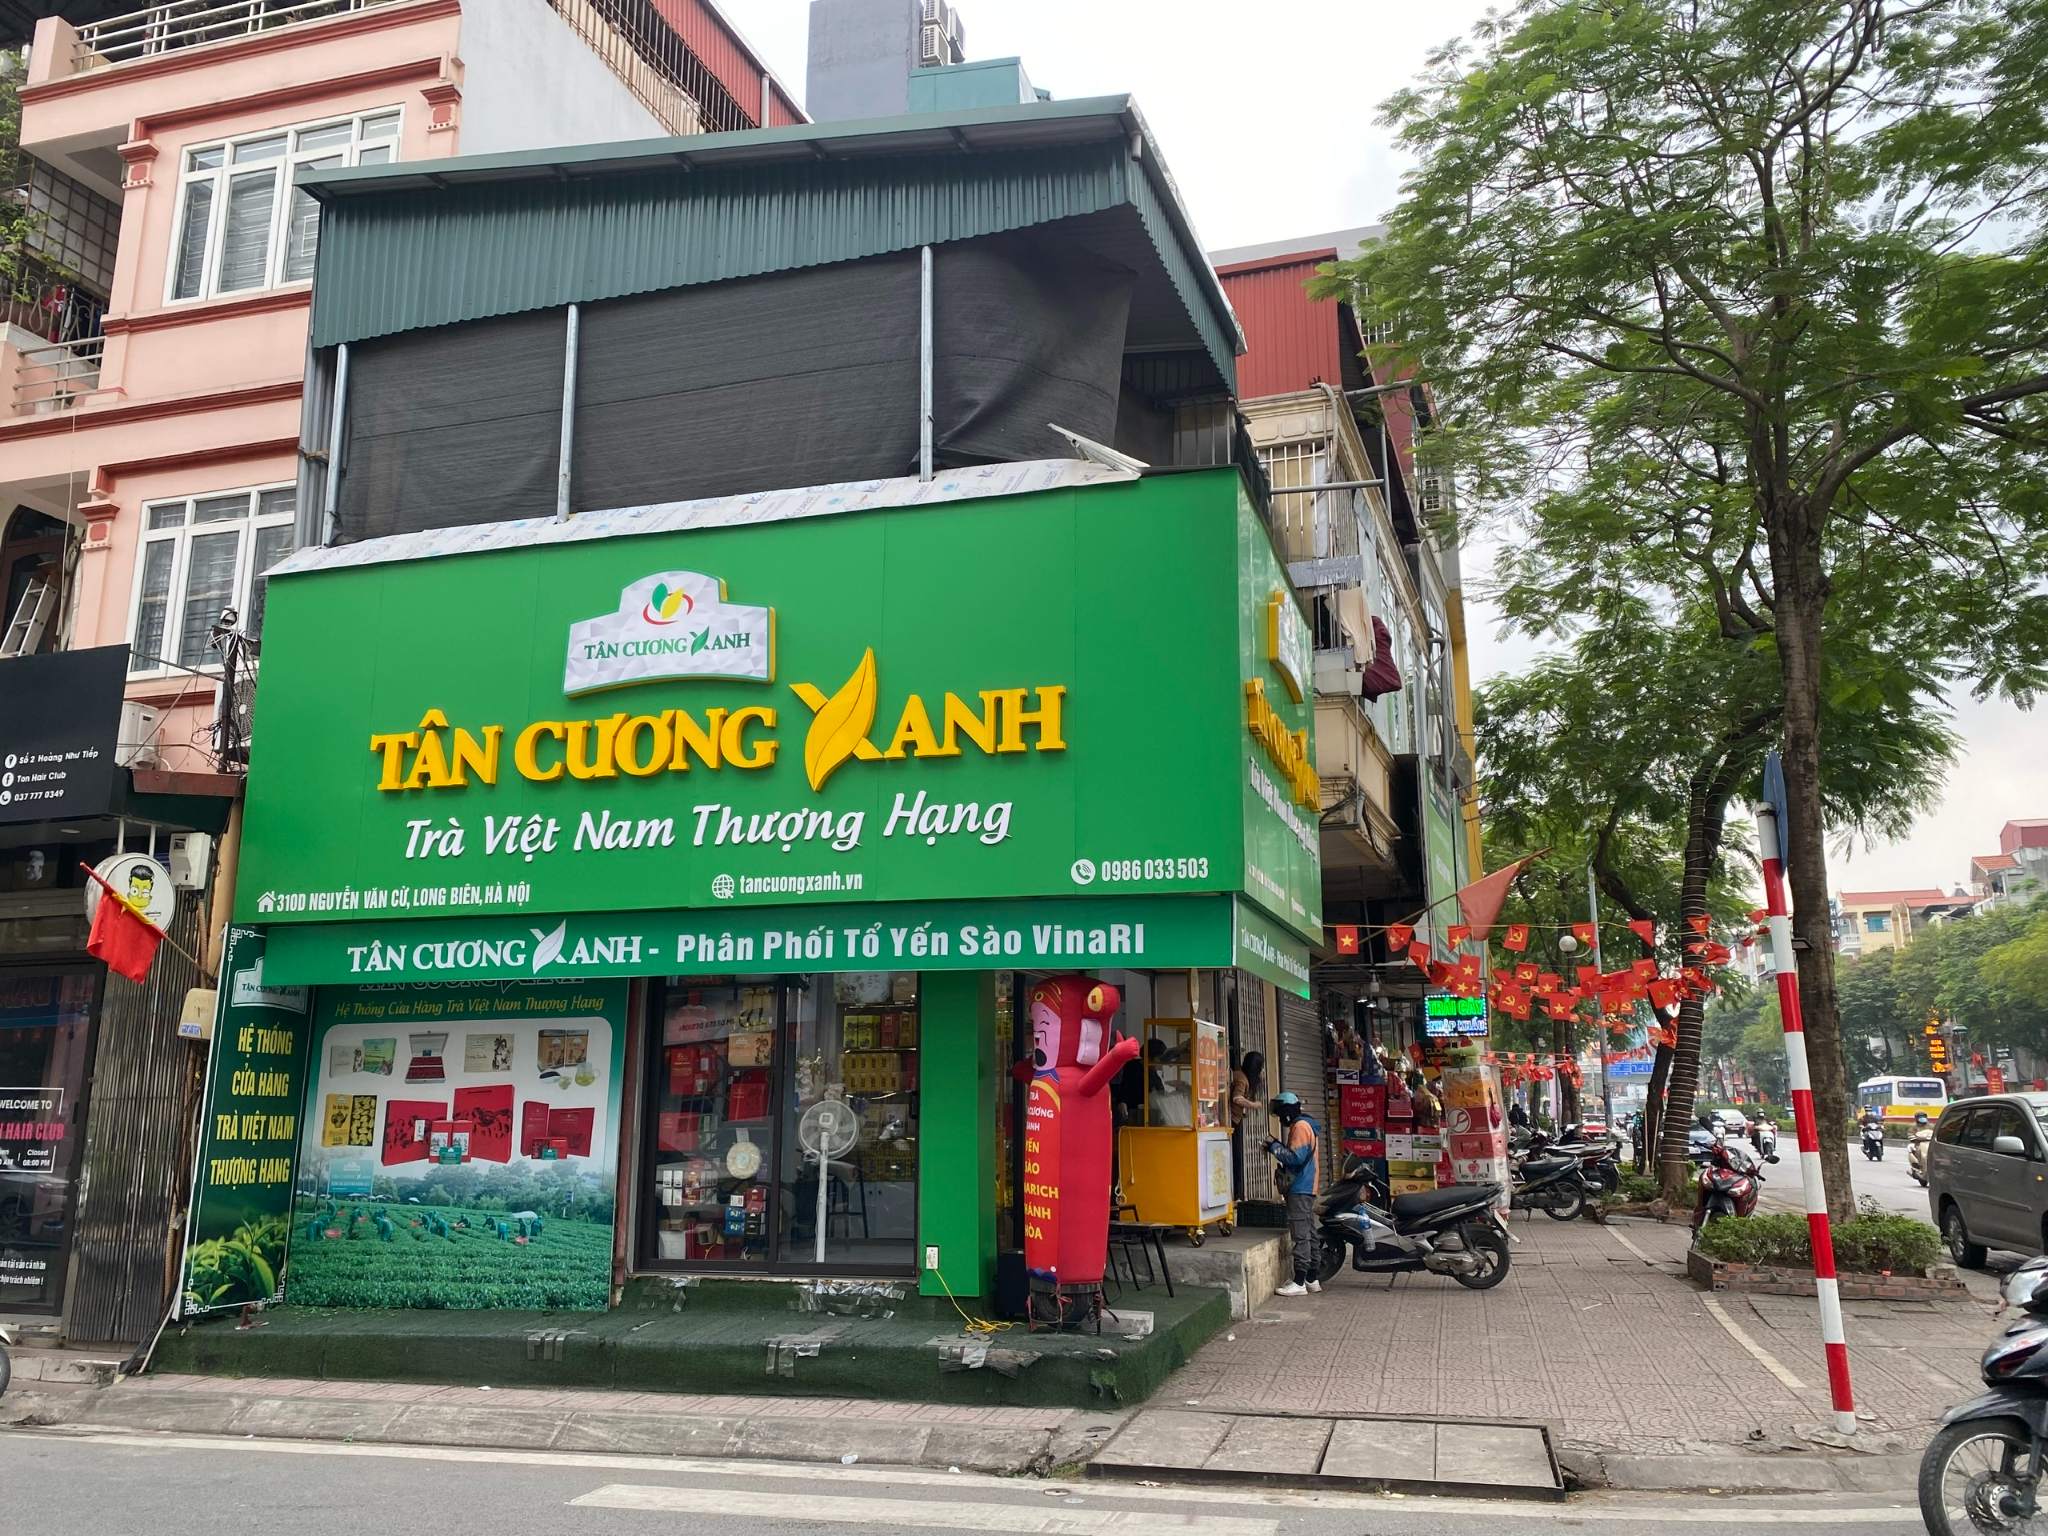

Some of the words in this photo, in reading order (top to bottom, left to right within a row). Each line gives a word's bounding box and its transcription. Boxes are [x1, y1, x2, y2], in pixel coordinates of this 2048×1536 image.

[584, 640, 619, 660] TÂN
[623, 637, 687, 658] CƯƠNG
[30, 755, 35, 763] 2
[370, 707, 503, 792] TÂN
[514, 705, 779, 782] CƯƠNG
[31, 773, 47, 782] Hair
[48, 771, 66, 780] Club
[14, 792, 28, 801] 037
[29, 791, 43, 800] 777
[44, 789, 64, 799] 0349
[404, 817, 466, 859] Trà
[484, 813, 561, 862] Việt
[574, 809, 675, 852] Nam
[692, 803, 865, 853] Thượng
[883, 790, 1014, 846] Hạng
[1102, 860, 1141, 882] 0986
[1144, 858, 1175, 880] 033
[1177, 857, 1209, 879] 503
[739, 871, 863, 895] tancuongxanh.vn
[277, 893, 306, 912] 310D
[309, 885, 360, 911] NGUYỄN
[364, 887, 387, 909] VĂN
[413, 887, 447, 907] LONG
[485, 881, 503, 904] HÀ
[507, 881, 530, 906] NỘI
[347, 939, 407, 973] TÂN
[412, 939, 526, 971] CƯƠNG
[676, 932, 754, 963] Phân
[763, 924, 833, 961] Phối
[843, 921, 880, 959] Tổ
[889, 921, 949, 957] Yến
[959, 924, 1022, 956] Sào
[1032, 923, 1145, 956] VinaRI
[493, 998, 521, 1011] Nam
[571, 994, 605, 1011] Hạng
[238, 1022, 255, 1058] HỆ
[256, 1021, 293, 1055] THỐNG
[231, 1062, 255, 1096] CỬA
[257, 1067, 290, 1097] HÀNG
[41, 1100, 52, 1110] TO
[5, 1122, 33, 1140] HAIR
[36, 1122, 65, 1140] CLUB
[216, 1109, 238, 1140] TRÀ
[241, 1109, 267, 1146] VIỆT
[267, 1115, 295, 1140] NAM
[210, 1157, 257, 1190] THƯỢNG
[258, 1158, 290, 1188] HẠNG
